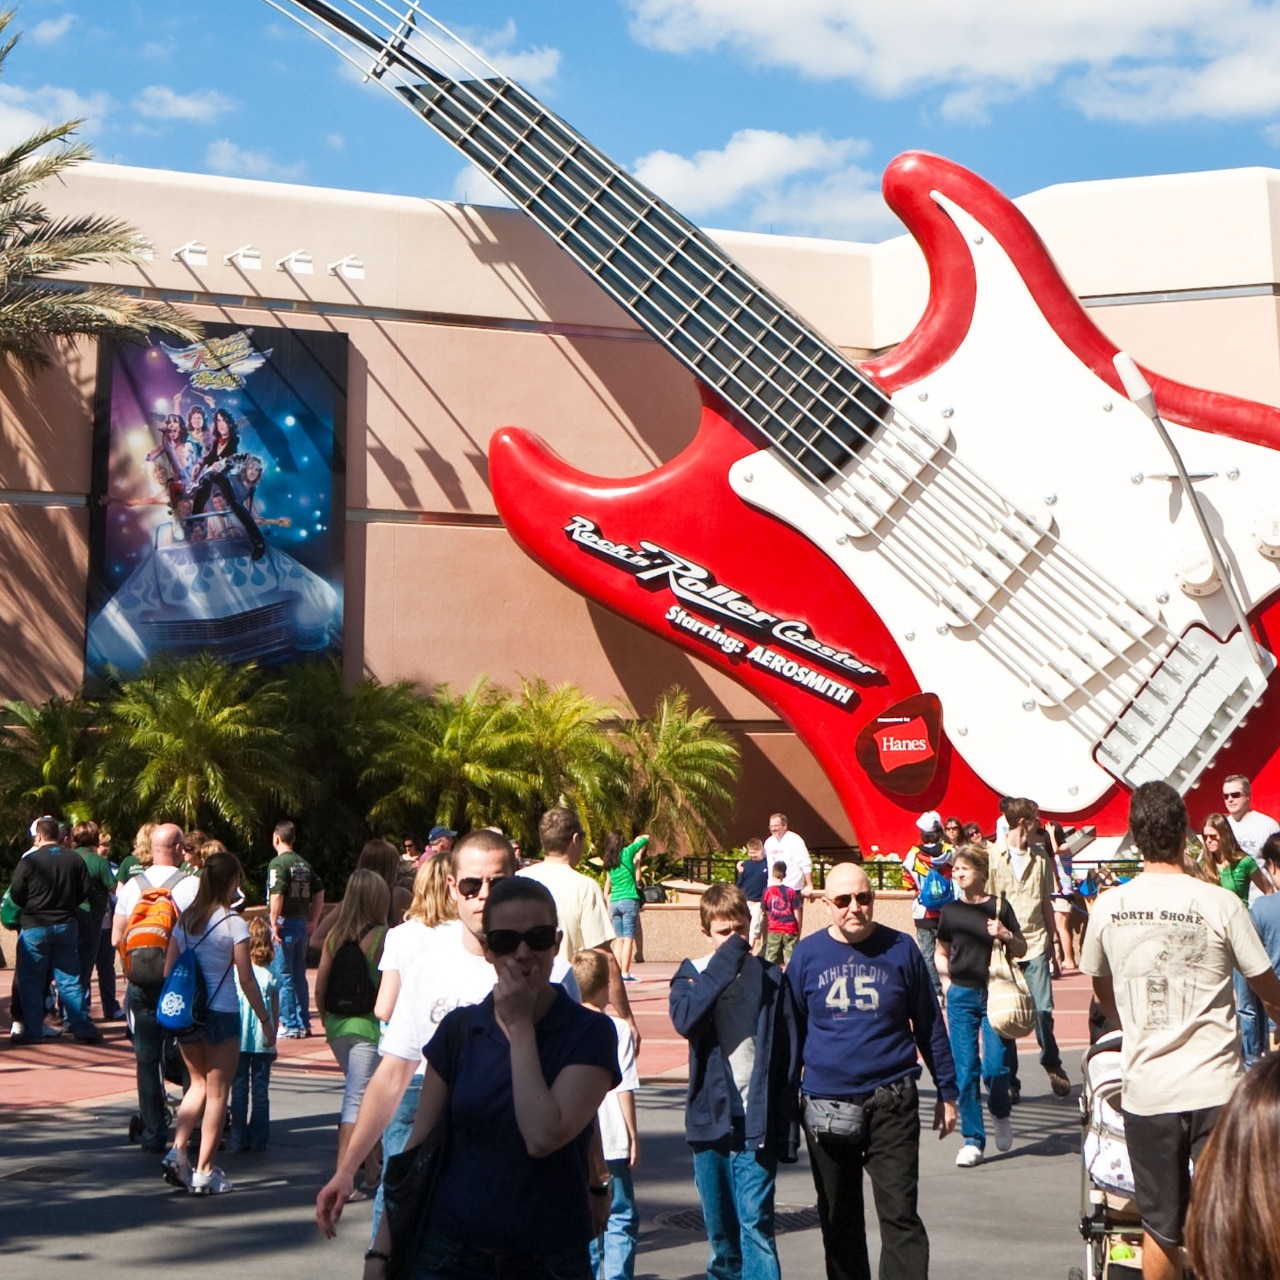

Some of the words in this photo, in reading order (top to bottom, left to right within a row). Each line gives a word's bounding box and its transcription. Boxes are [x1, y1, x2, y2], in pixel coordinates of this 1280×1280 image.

[635, 540, 778, 629] Roller
[772, 621, 877, 676] Coaster
[665, 605, 744, 653] Starring:
[747, 645, 855, 705] AEROSMITH
[882, 736, 927, 752] Hanes
[1111, 911, 1154, 924] NORTH
[1160, 910, 1203, 926] SHORE
[818, 963, 867, 989] ATHLETIC
[825, 975, 880, 1013] 45
